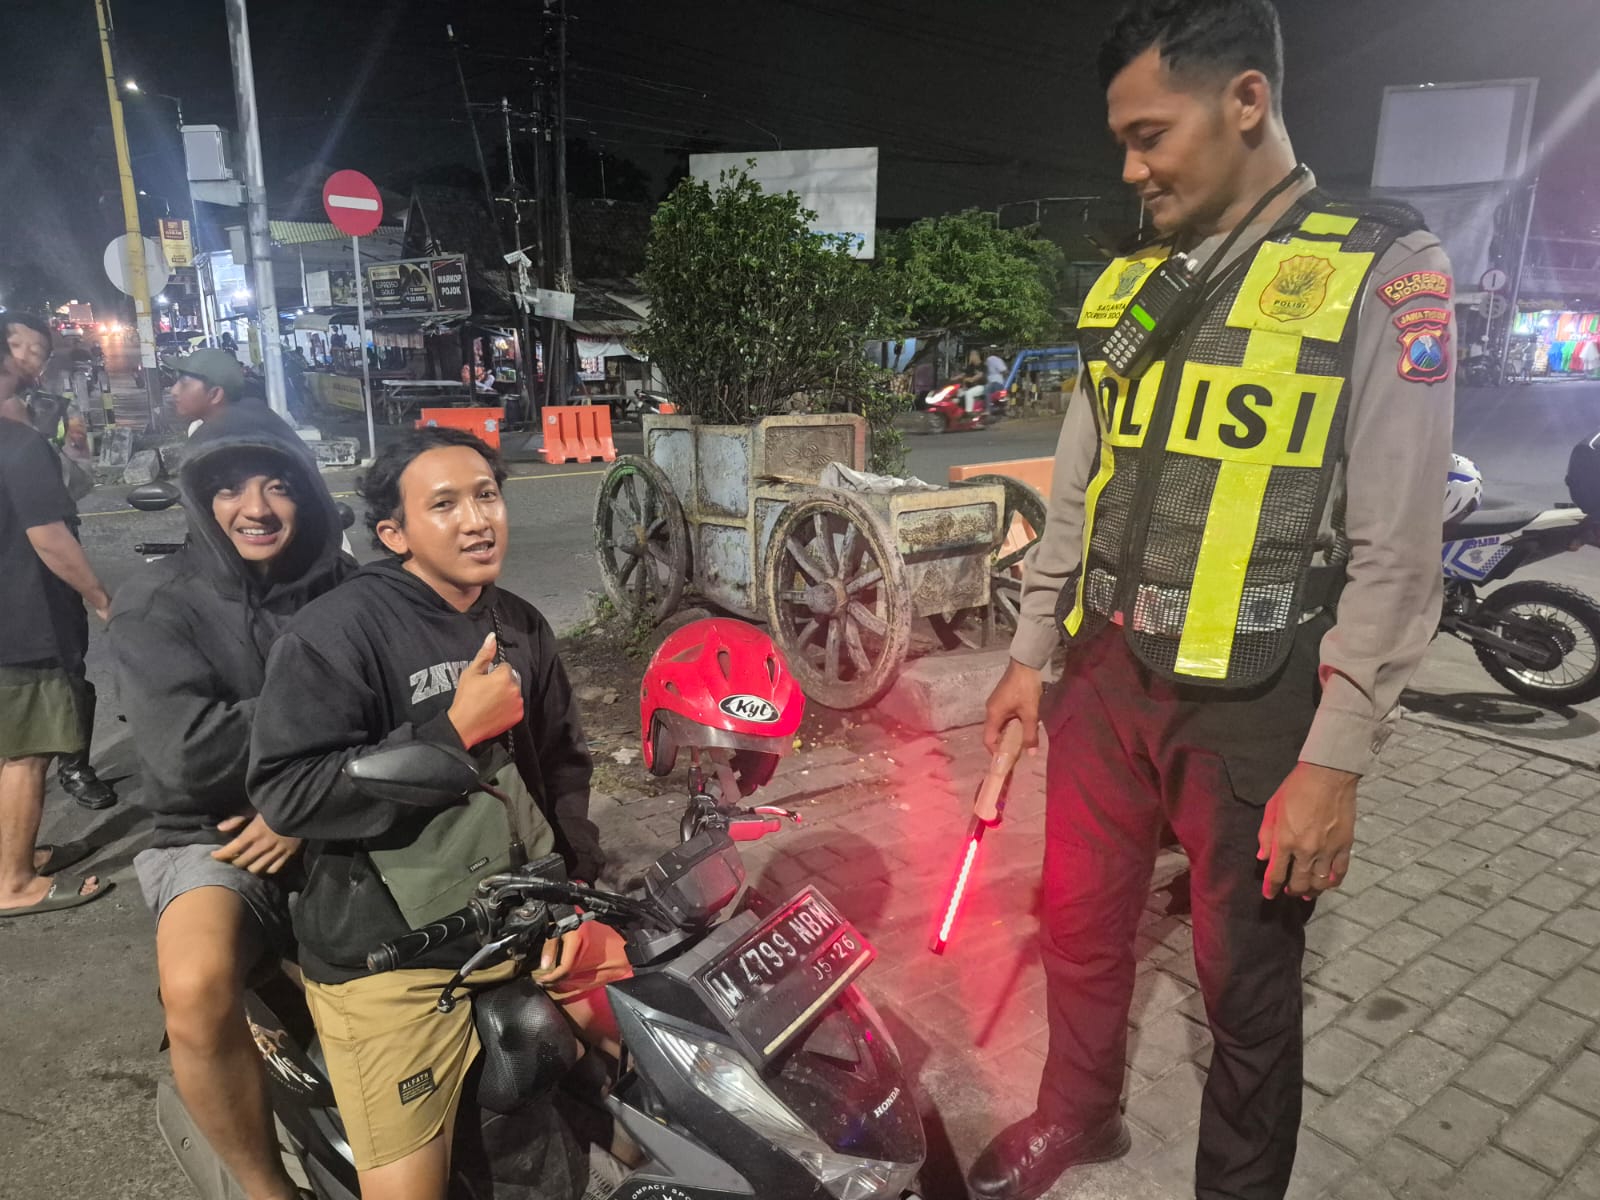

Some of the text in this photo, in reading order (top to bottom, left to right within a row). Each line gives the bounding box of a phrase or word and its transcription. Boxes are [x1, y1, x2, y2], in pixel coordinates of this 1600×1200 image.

[437, 274, 462, 284] WARKOP
[441, 286, 461, 295] POJOK
[1273, 300, 1305, 309] POLISI
[711, 971, 744, 1007] W
[739, 932, 797, 984] 4799
[873, 1087, 900, 1118] HONDA
[631, 1184, 666, 1200] OMPACT
